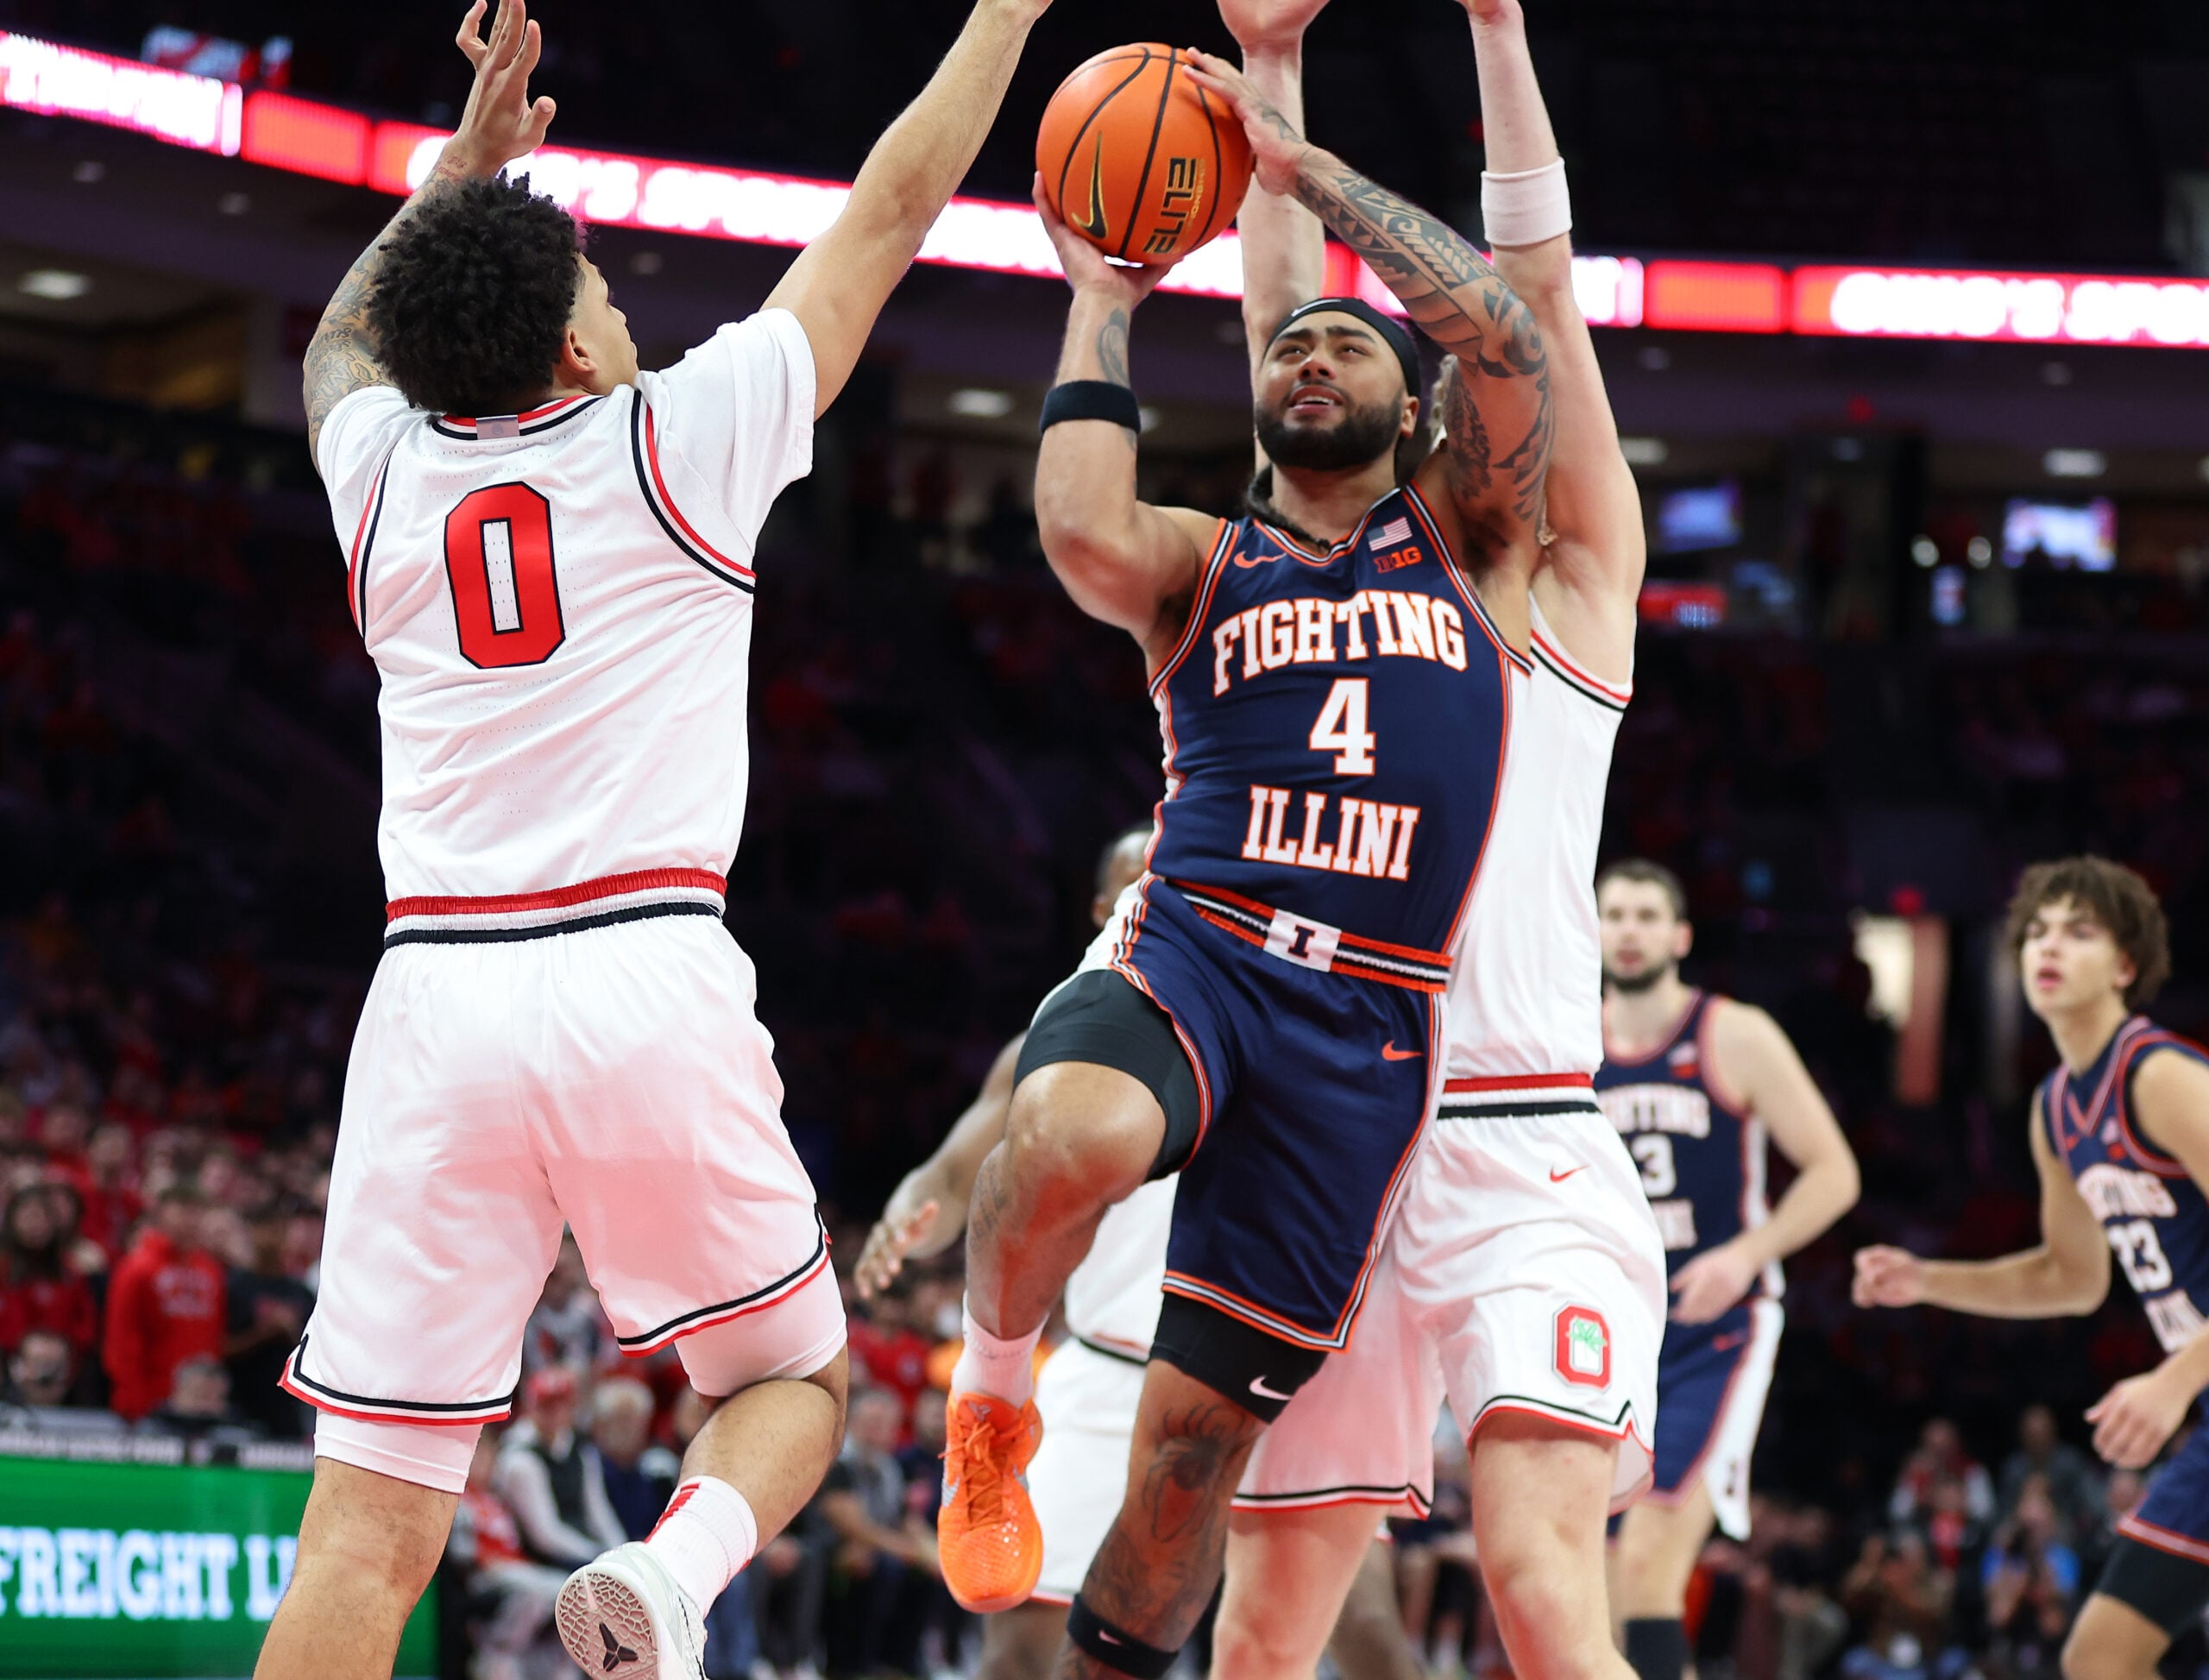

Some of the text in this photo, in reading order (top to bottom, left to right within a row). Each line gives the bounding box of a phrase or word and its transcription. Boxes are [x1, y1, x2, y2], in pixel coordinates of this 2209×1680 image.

[1142, 157, 1197, 254] ELITE
[444, 481, 566, 670] 0
[1212, 589, 1469, 698] FIGHTING
[1308, 677, 1376, 776] 4
[1241, 784, 1421, 882] ILLINI
[1287, 923, 1317, 960] I
[1629, 1133, 1677, 1199] 3
